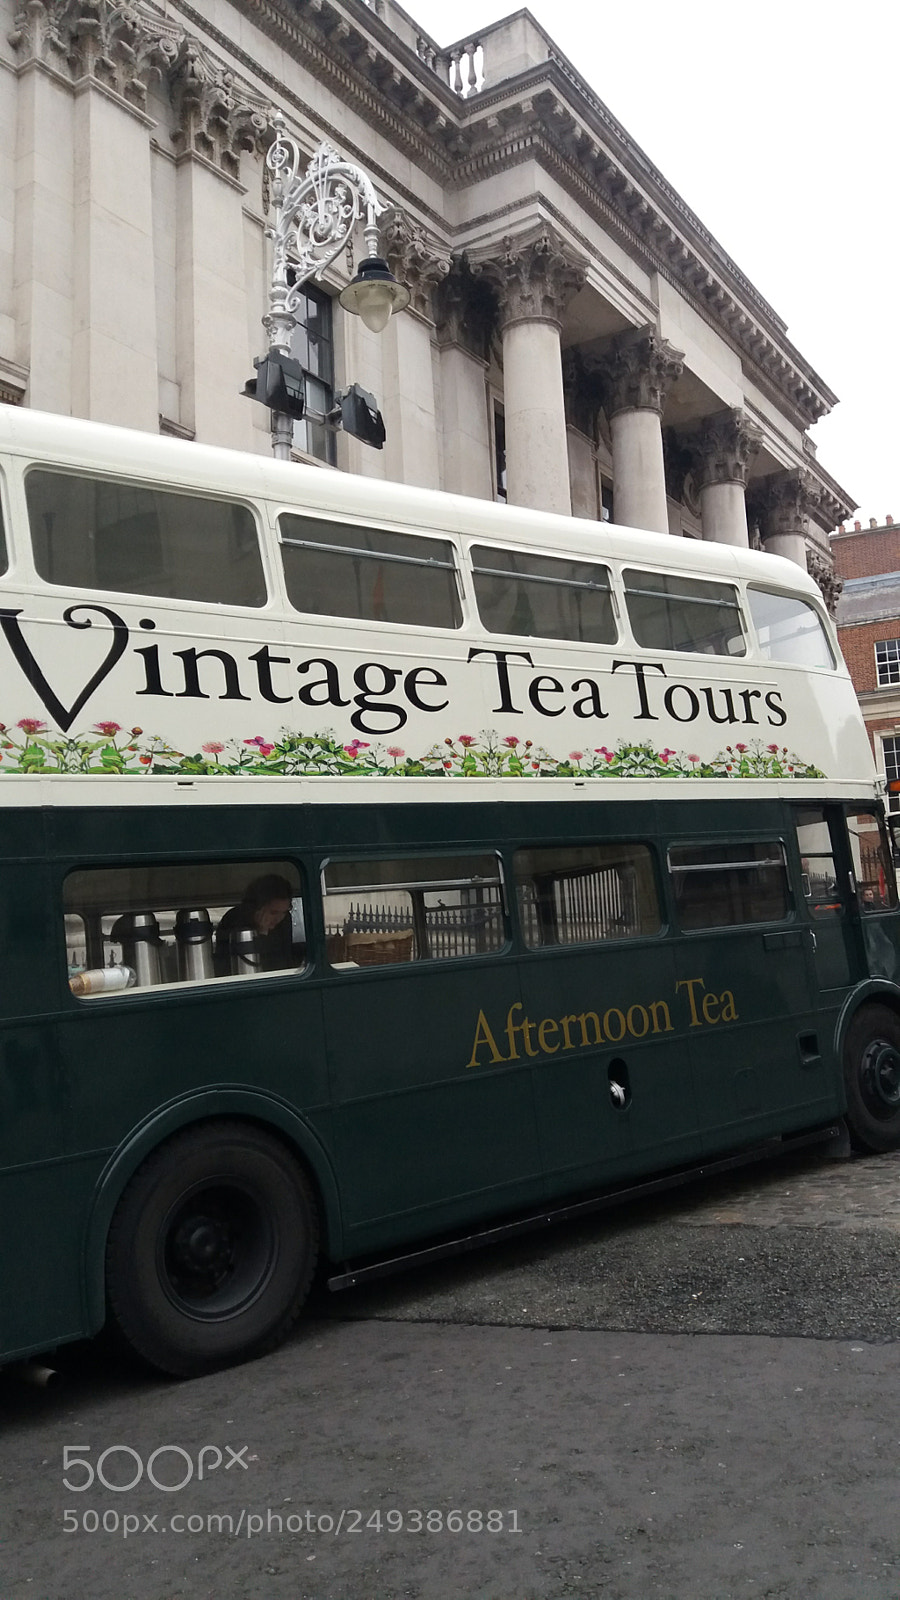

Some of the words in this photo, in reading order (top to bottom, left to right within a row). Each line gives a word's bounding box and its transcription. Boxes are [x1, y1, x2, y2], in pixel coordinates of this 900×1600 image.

[0, 604, 449, 735] Vintage
[467, 647, 609, 719] Tea
[611, 659, 788, 726] Tours
[465, 1002, 674, 1068] Afternoon
[675, 978, 739, 1027] Tea
